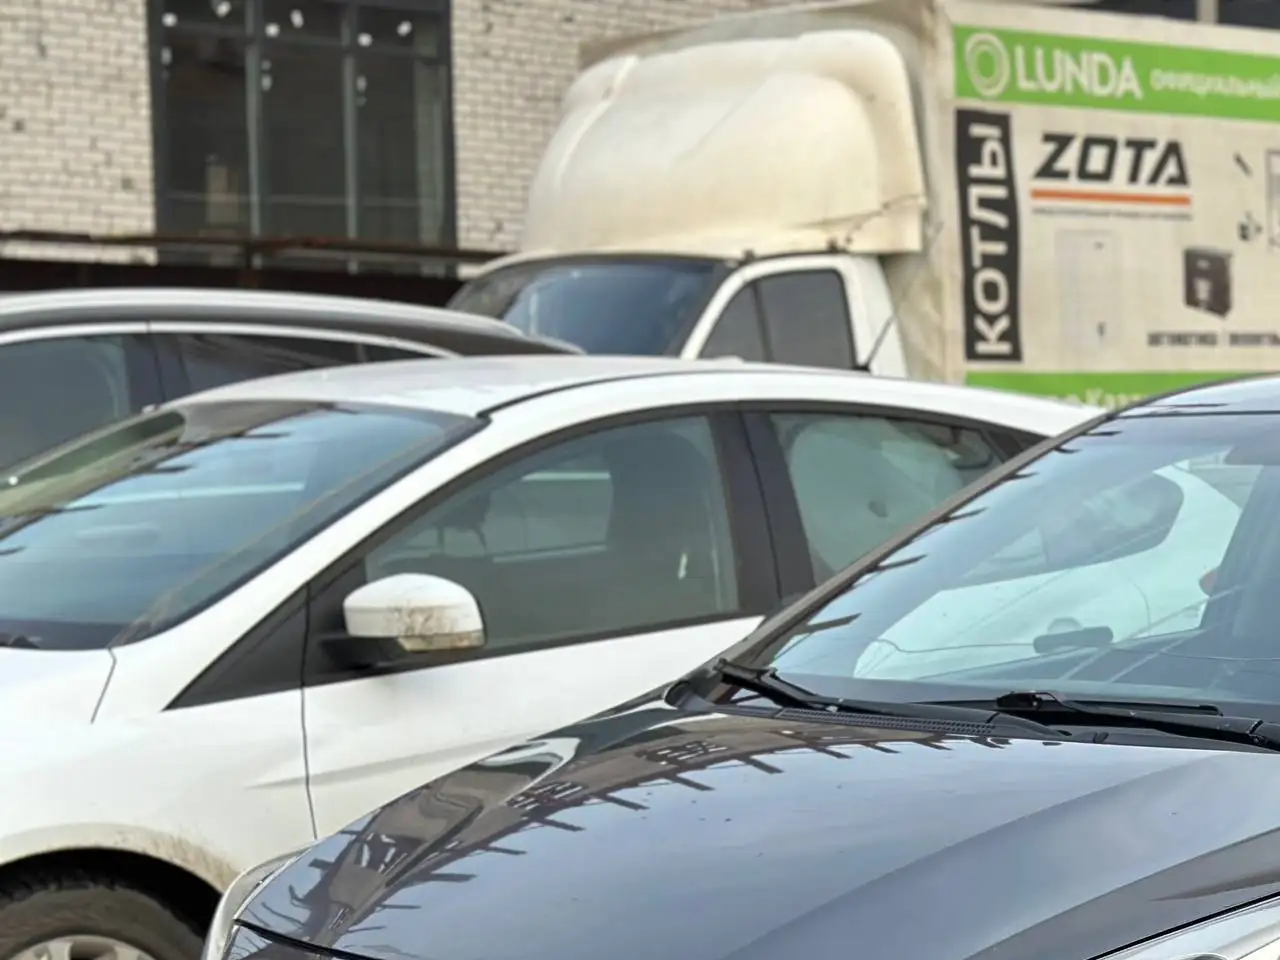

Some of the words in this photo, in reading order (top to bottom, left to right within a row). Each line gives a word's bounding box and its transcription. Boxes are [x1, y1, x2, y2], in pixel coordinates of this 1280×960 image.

[1014, 46, 1143, 100] LUNDA
[1033, 132, 1190, 187] ZOTA
[967, 123, 1012, 355] КОТЛЫ
